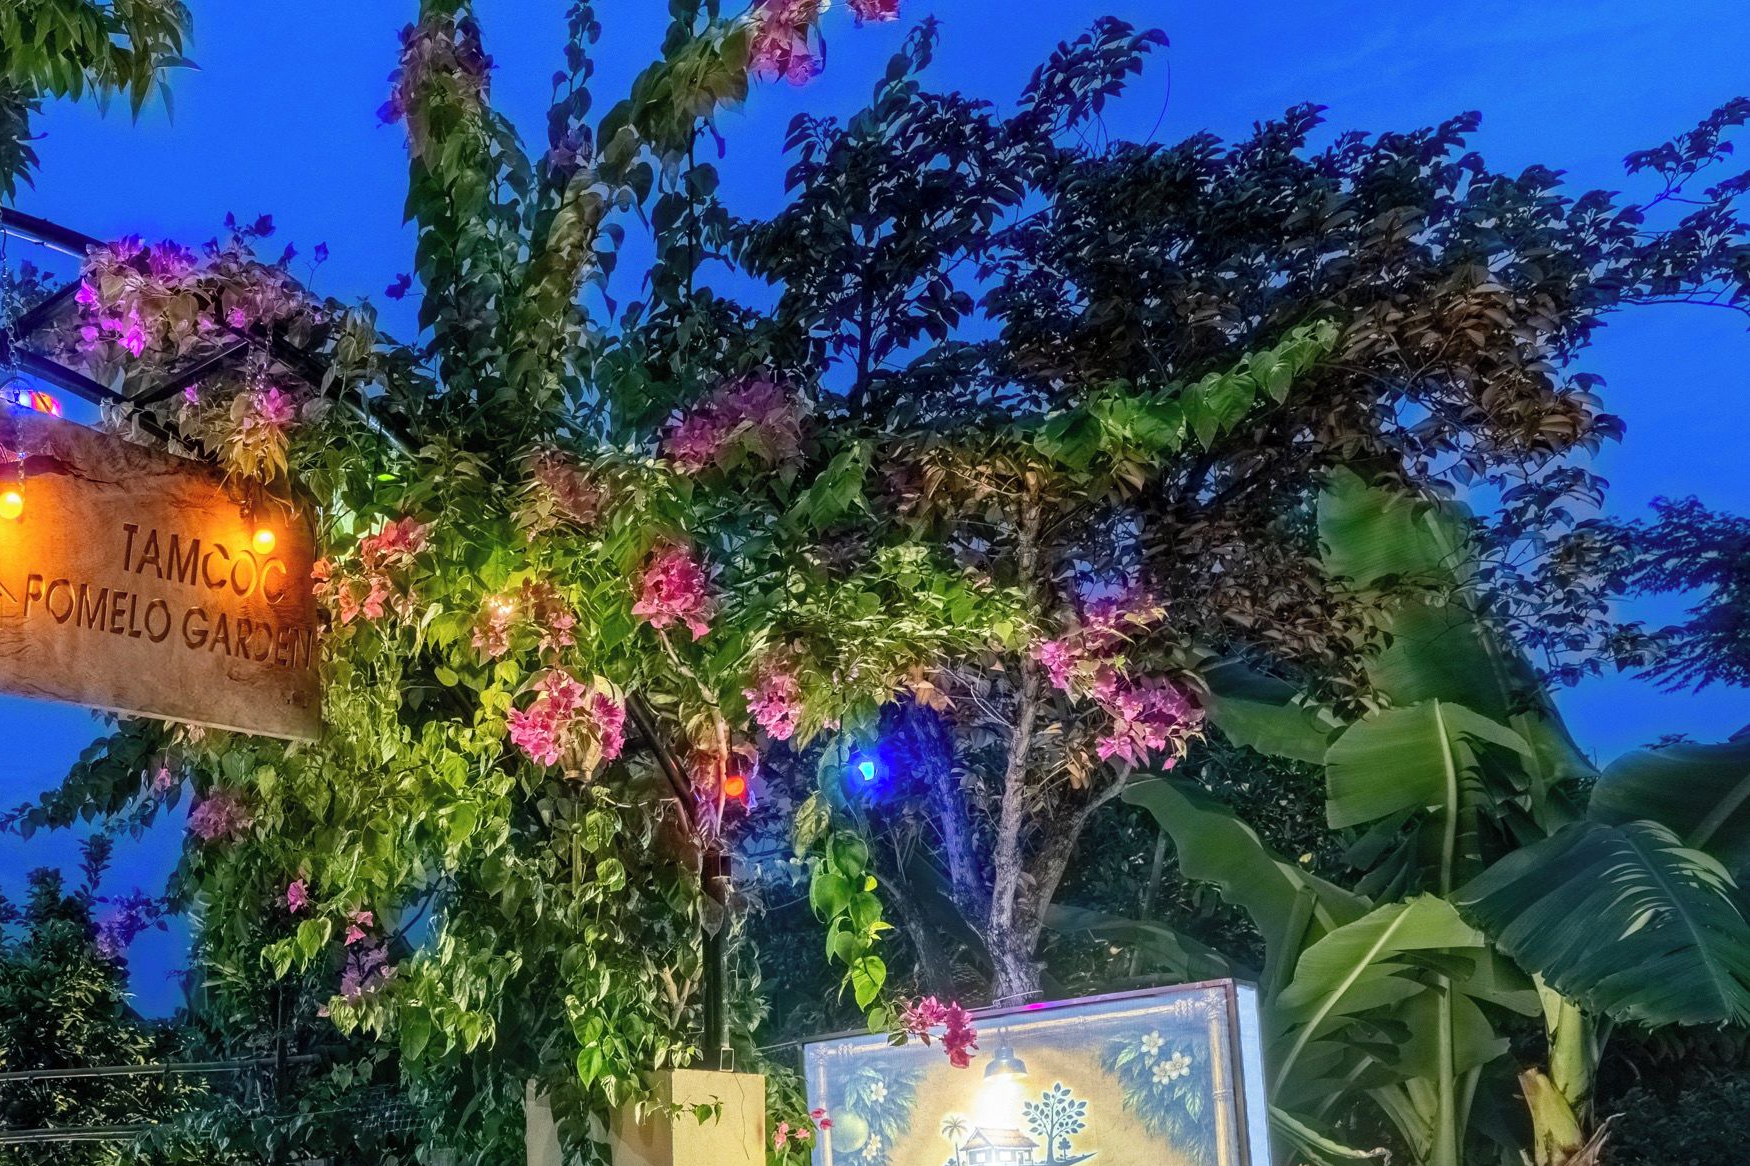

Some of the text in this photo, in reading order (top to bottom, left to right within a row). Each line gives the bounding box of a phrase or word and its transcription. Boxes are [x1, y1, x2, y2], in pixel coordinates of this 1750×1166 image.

[123, 523, 287, 605] TAMCOC
[23, 574, 313, 671] POMELO GARDEN
